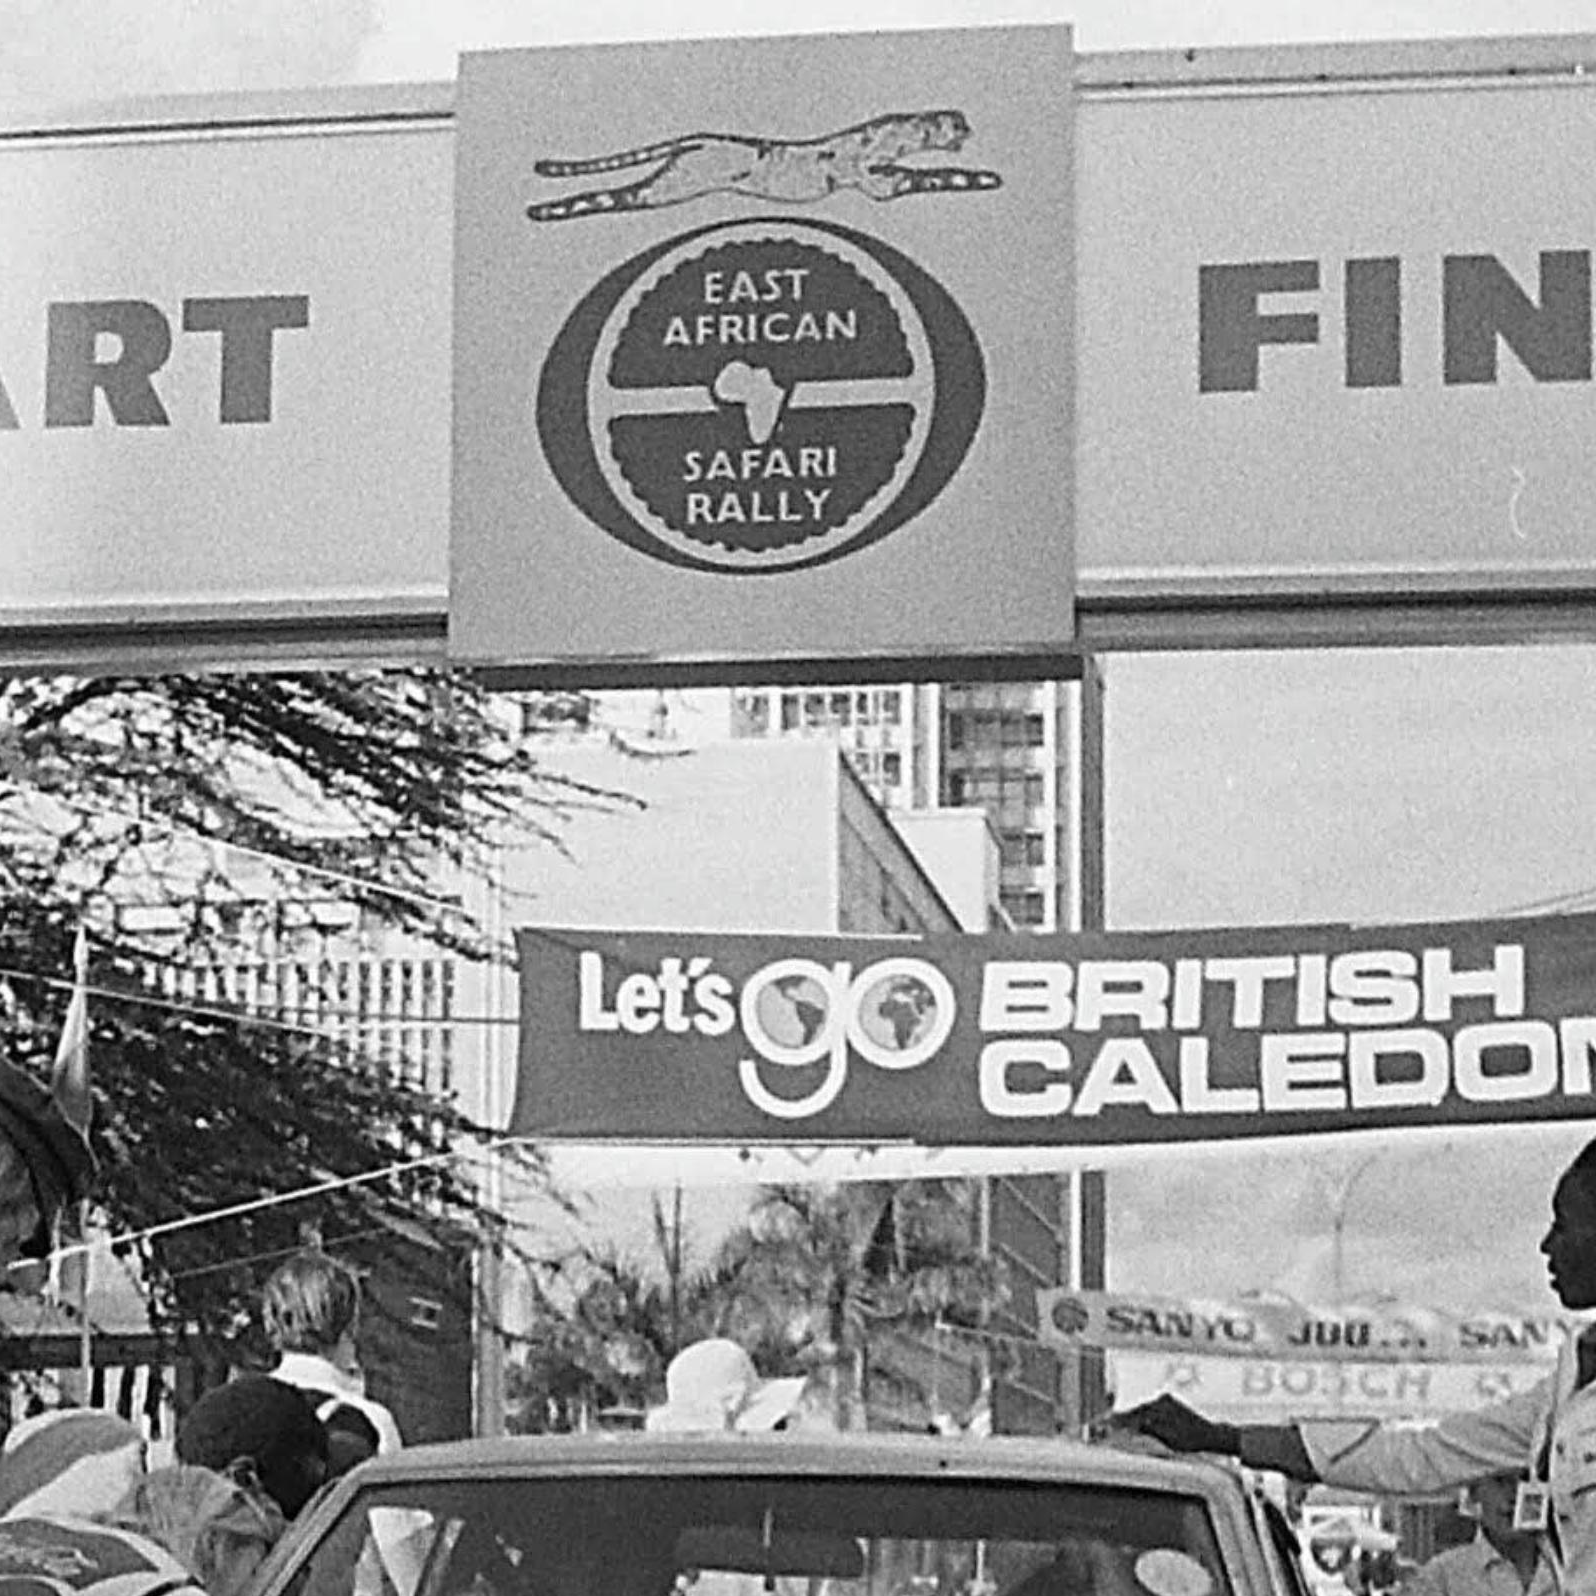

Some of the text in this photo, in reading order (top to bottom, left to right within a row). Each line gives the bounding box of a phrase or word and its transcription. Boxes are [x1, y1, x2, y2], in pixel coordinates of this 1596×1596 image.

[703, 268, 811, 305] EAST
[662, 309, 859, 346] AFRICAN
[682, 447, 838, 483] SAFARI
[685, 488, 833, 525] RALLY
[578, 949, 736, 1037] Let's
[978, 942, 1525, 1034] BRITISH
[1106, 1304, 1257, 1341] SANYO
